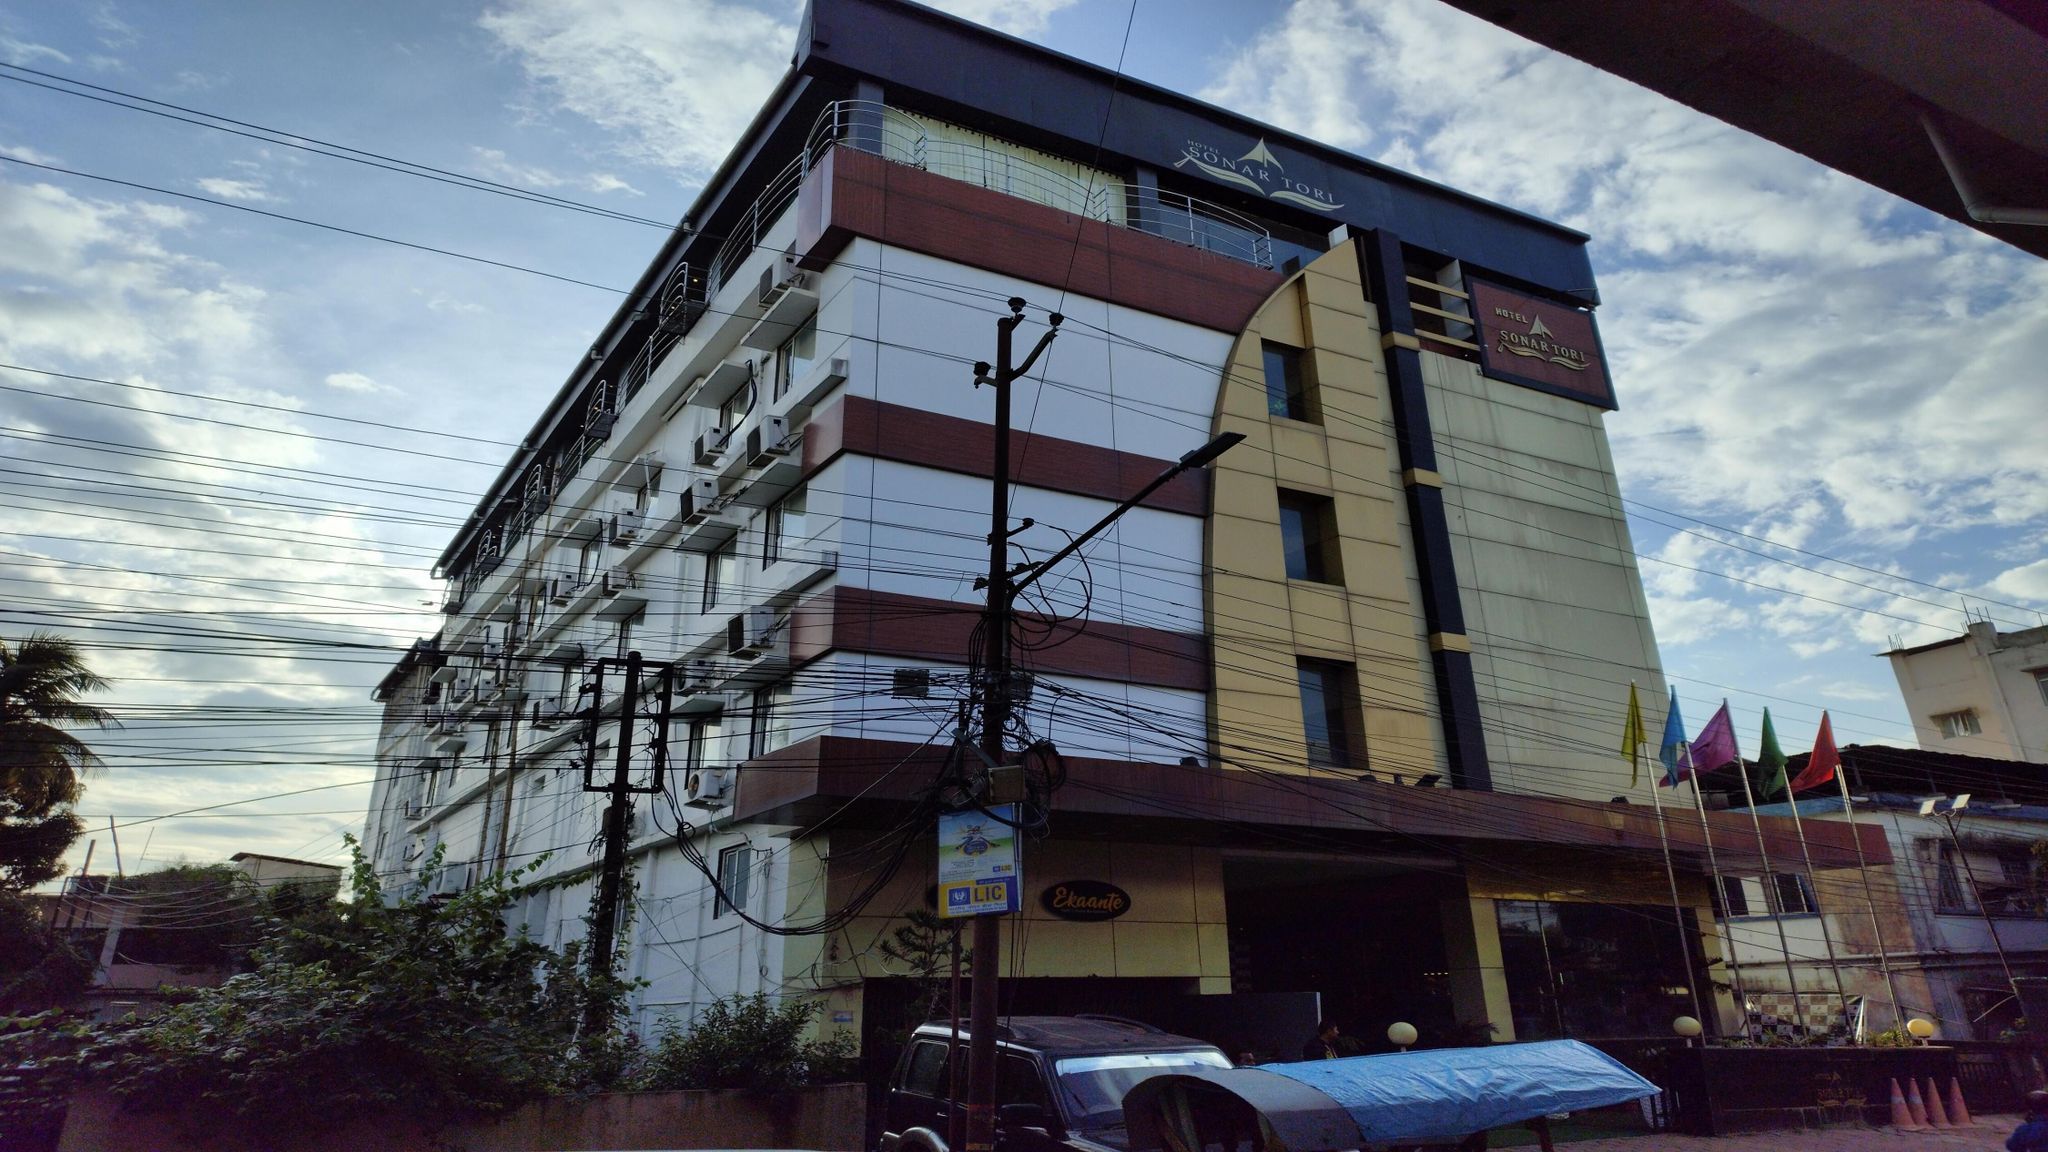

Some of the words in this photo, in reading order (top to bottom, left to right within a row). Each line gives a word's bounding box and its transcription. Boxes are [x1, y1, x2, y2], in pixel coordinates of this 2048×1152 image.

[1187, 139, 1220, 155] HOTEL
[1189, 146, 1270, 182] SONAR
[1281, 176, 1334, 203] TORI
[1495, 307, 1529, 324] HOTEL
[1500, 330, 1549, 352] SONAR
[1551, 344, 1585, 362] TORI
[974, 885, 1002, 902] LIC
[1053, 886, 1125, 912] Ekaante
